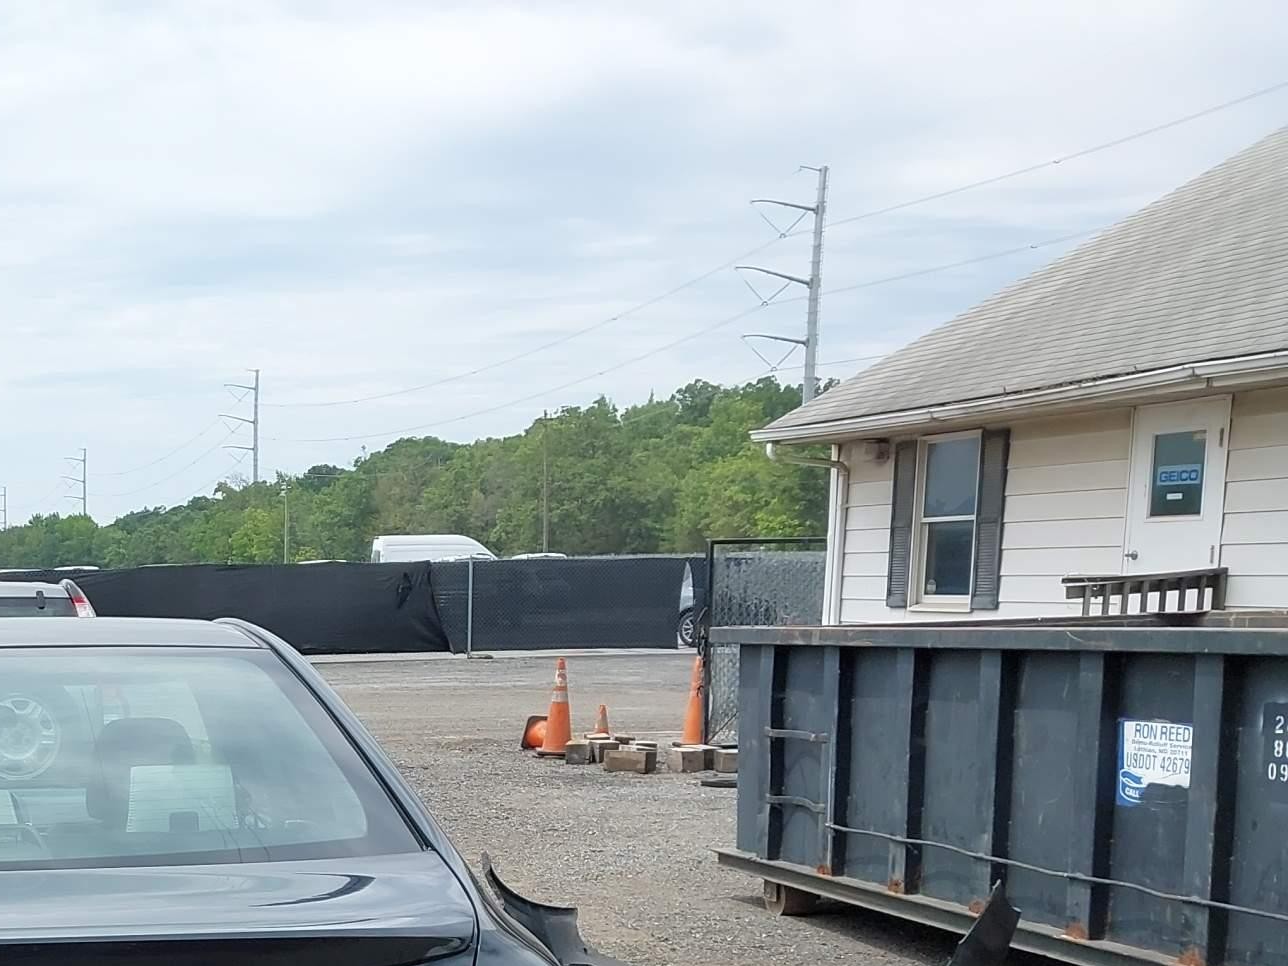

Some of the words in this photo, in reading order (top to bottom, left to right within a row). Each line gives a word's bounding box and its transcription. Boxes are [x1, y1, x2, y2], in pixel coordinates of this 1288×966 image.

[1159, 469, 1199, 483] GEICO
[1134, 723, 1158, 741] RON
[1160, 725, 1191, 742] REED
[1275, 715, 1288, 734] 2
[1274, 739, 1288, 758] 8
[1126, 752, 1157, 771] USDOT
[1160, 757, 1190, 775] 42679
